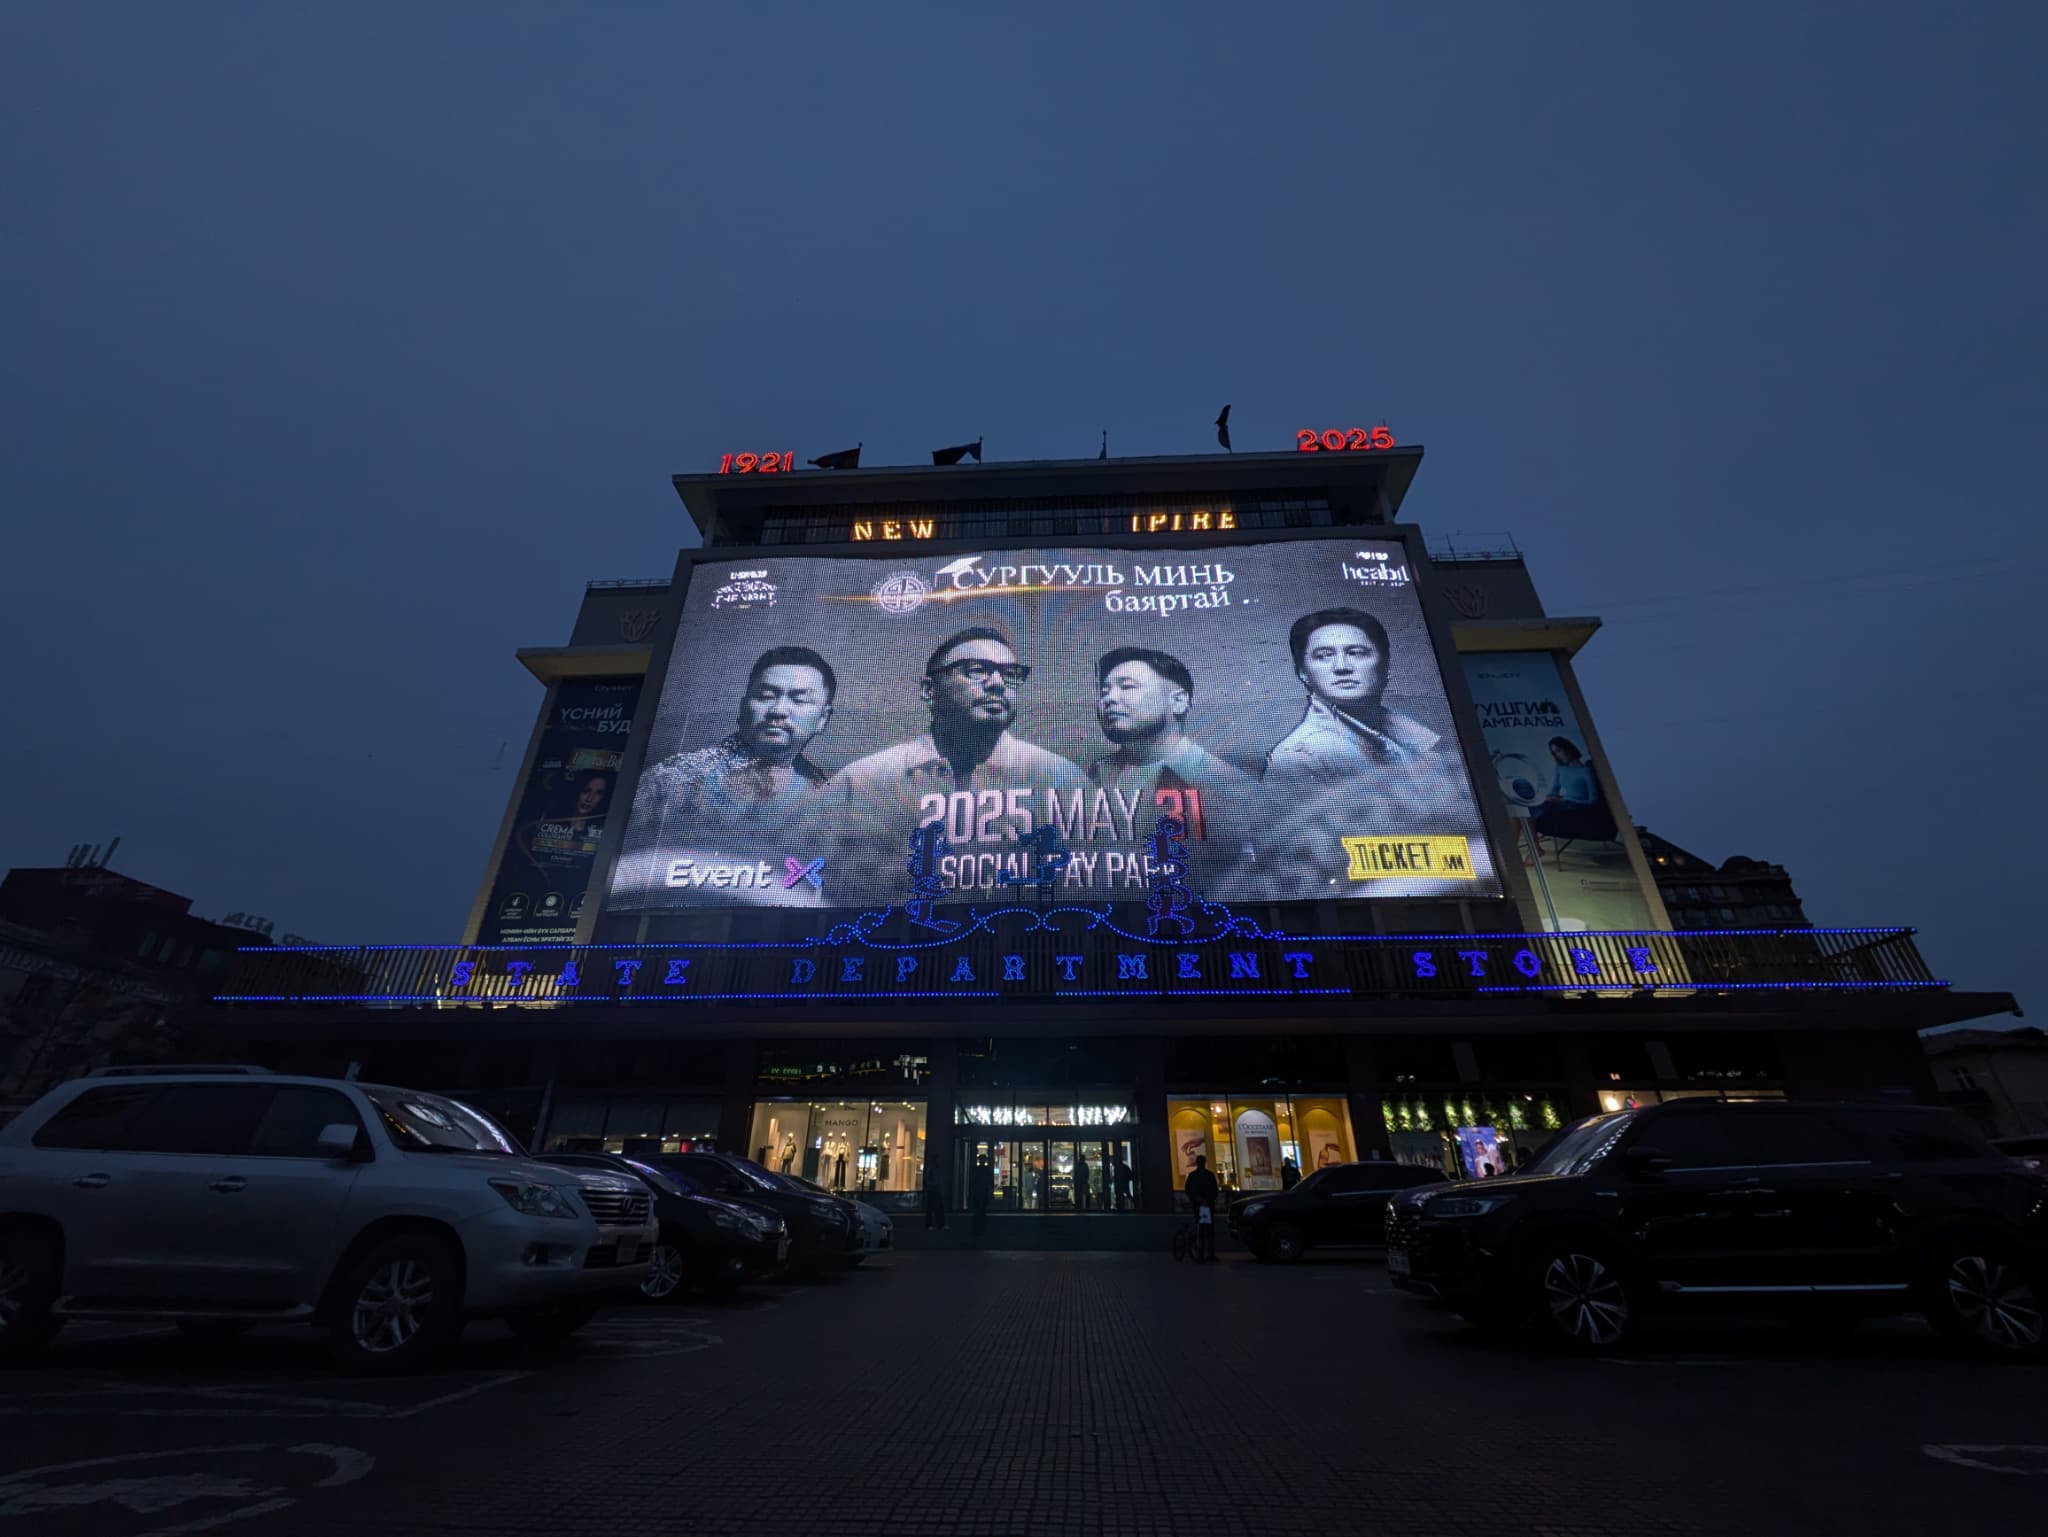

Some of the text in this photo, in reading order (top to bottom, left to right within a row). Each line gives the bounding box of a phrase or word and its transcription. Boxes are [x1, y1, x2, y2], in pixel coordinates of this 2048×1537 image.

[1297, 425, 1396, 453] 2025
[719, 450, 795, 476] 1921
[852, 518, 936, 542] NEW
[953, 563, 1235, 591] СУРГУУЛЬ МИНЬ
[1104, 588, 1231, 618] баяртай
[920, 787, 1208, 845] 2025 MAY 31
[665, 859, 774, 889] Event
[451, 947, 1659, 987] STATE DEPARTMENT STORE
[825, 1119, 859, 1128] MANGO
